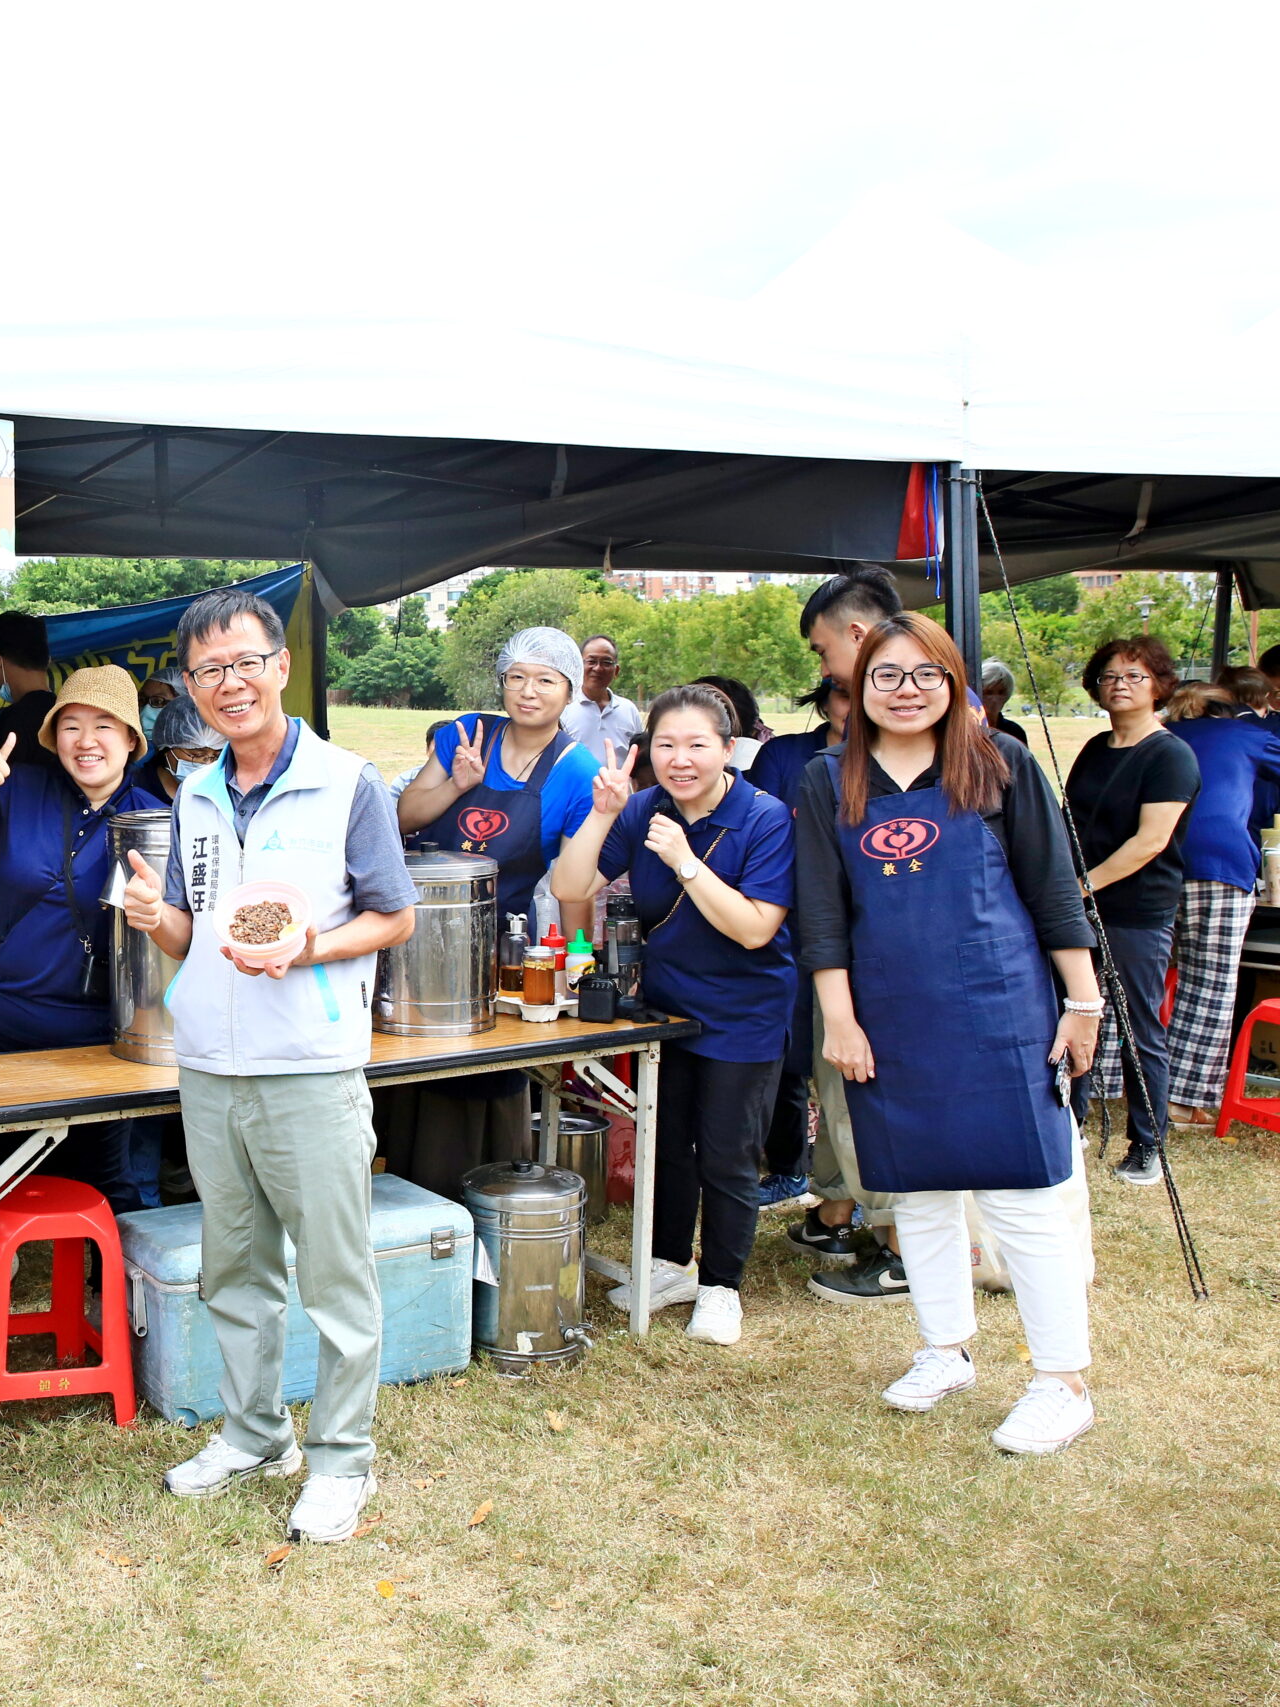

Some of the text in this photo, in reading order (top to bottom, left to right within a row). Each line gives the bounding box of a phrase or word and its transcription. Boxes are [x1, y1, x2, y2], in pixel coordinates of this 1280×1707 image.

[191, 836, 208, 912] 江盛任
[882, 858, 924, 876] 教全
